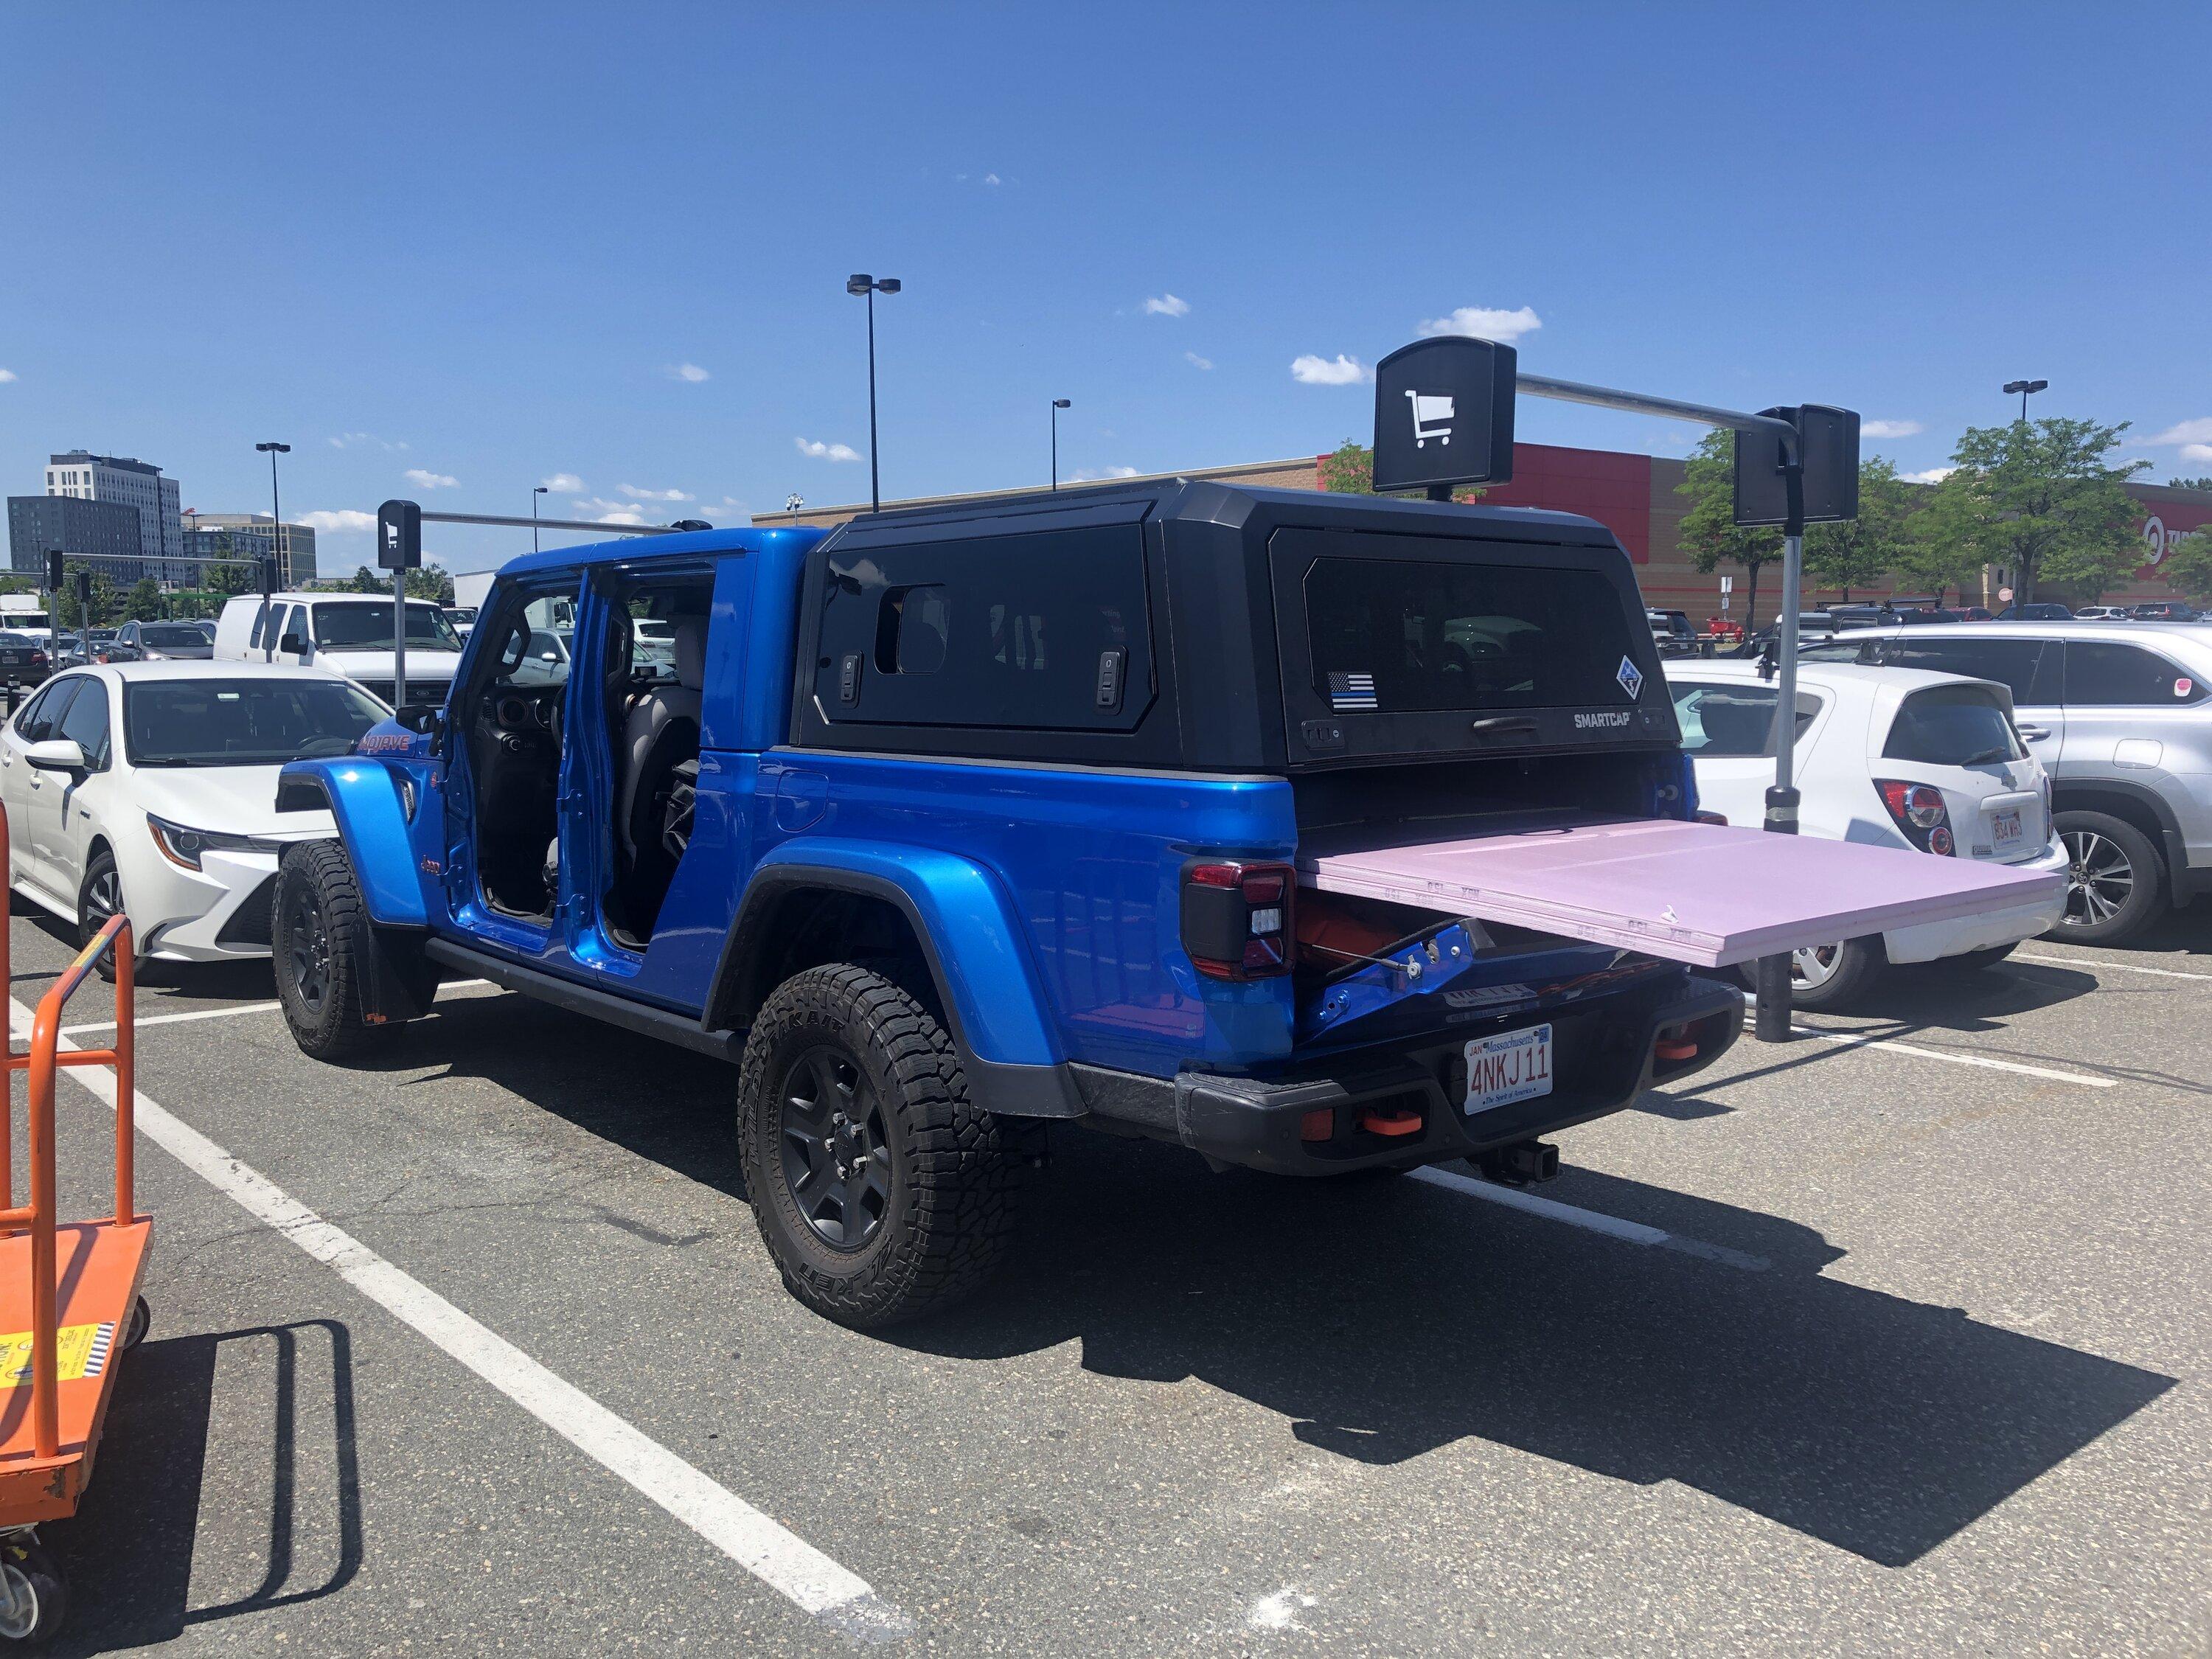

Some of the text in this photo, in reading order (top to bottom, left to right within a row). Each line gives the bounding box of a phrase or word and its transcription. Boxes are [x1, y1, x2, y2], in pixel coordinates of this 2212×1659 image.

[1574, 712, 1630, 728] SMARTCAP
[358, 734, 411, 753] MOJAVE
[1469, 1044, 1483, 1057] JAN
[1486, 1034, 1534, 1054] Massachusetts
[1486, 1095, 1494, 1105] The
[1495, 1091, 1508, 1102] Spirit
[1514, 1087, 1533, 1097] America
